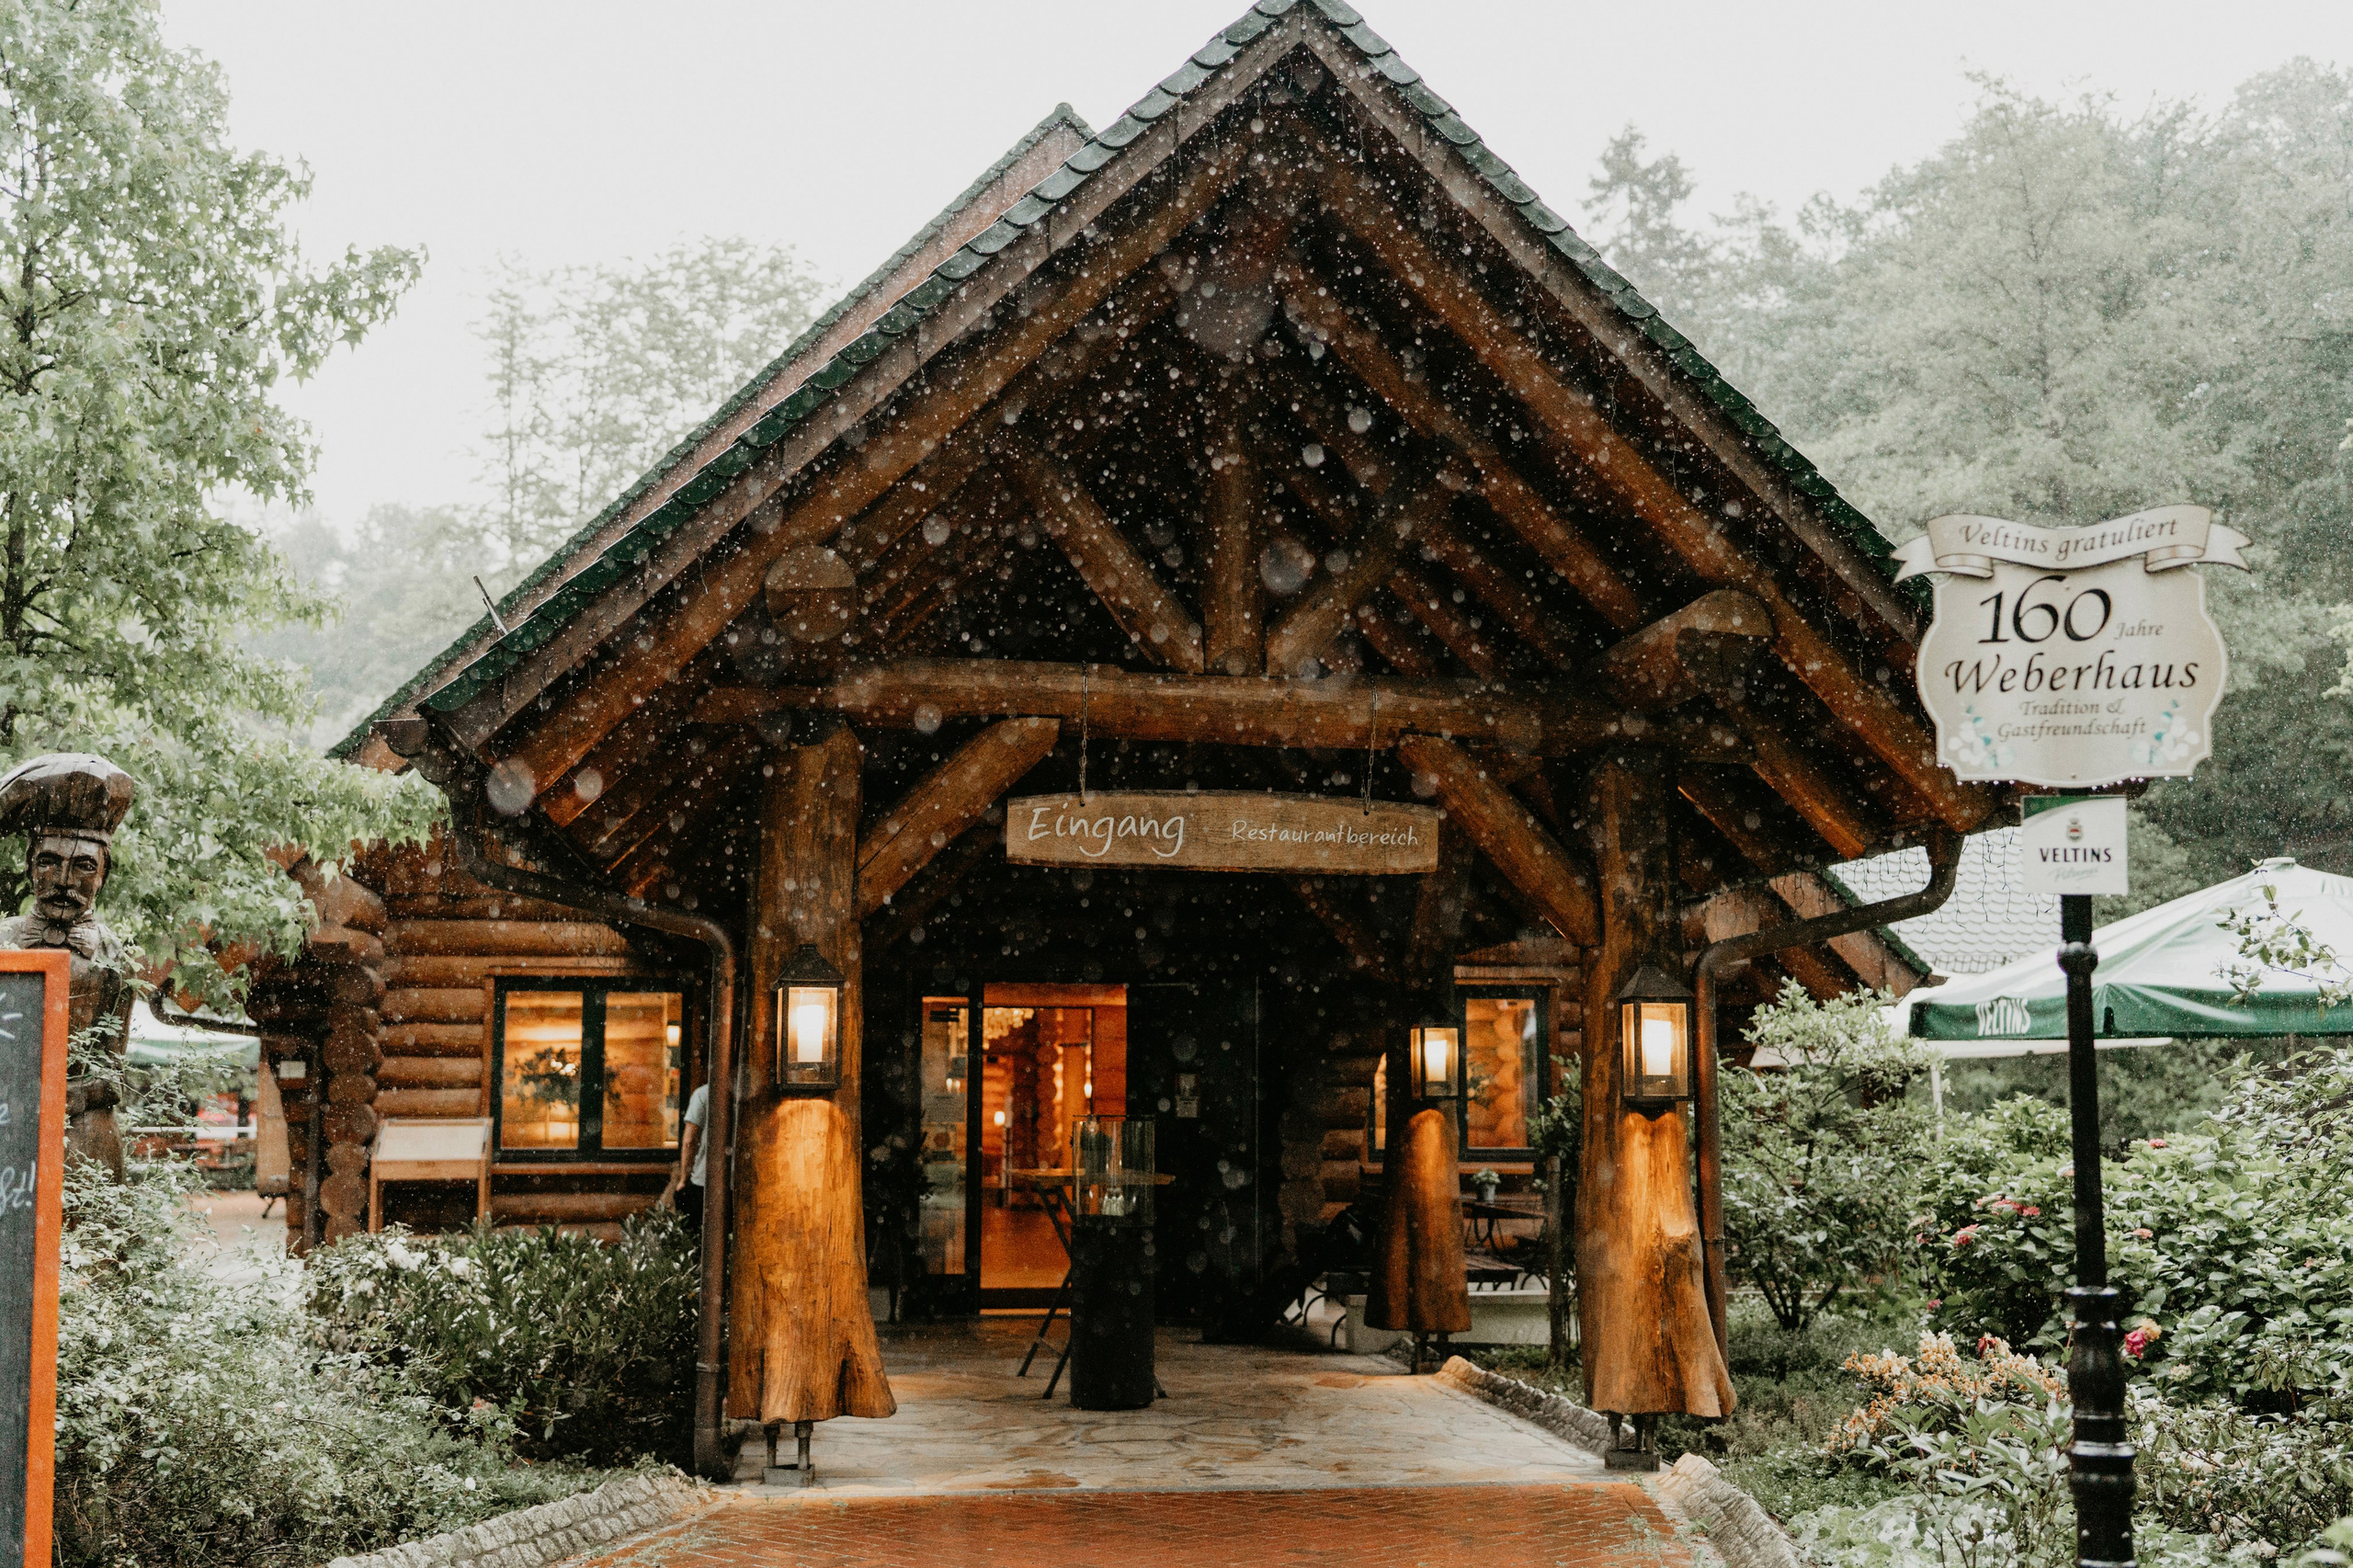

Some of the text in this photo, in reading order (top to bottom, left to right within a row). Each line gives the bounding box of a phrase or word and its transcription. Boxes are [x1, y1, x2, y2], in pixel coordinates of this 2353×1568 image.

[1959, 517, 2177, 561] Veltins gratuliert
[1978, 575, 2164, 643] 160 Jahre
[1945, 650, 2200, 694] Weberhaus
[2021, 698, 2125, 716] Tradition &
[1997, 717, 2146, 743] Gastfreundschaft
[1028, 802, 1419, 858] Eingang Restaurantbereich
[2040, 847, 2111, 862] VELTINS
[1975, 998, 2031, 1037] VELTINS
